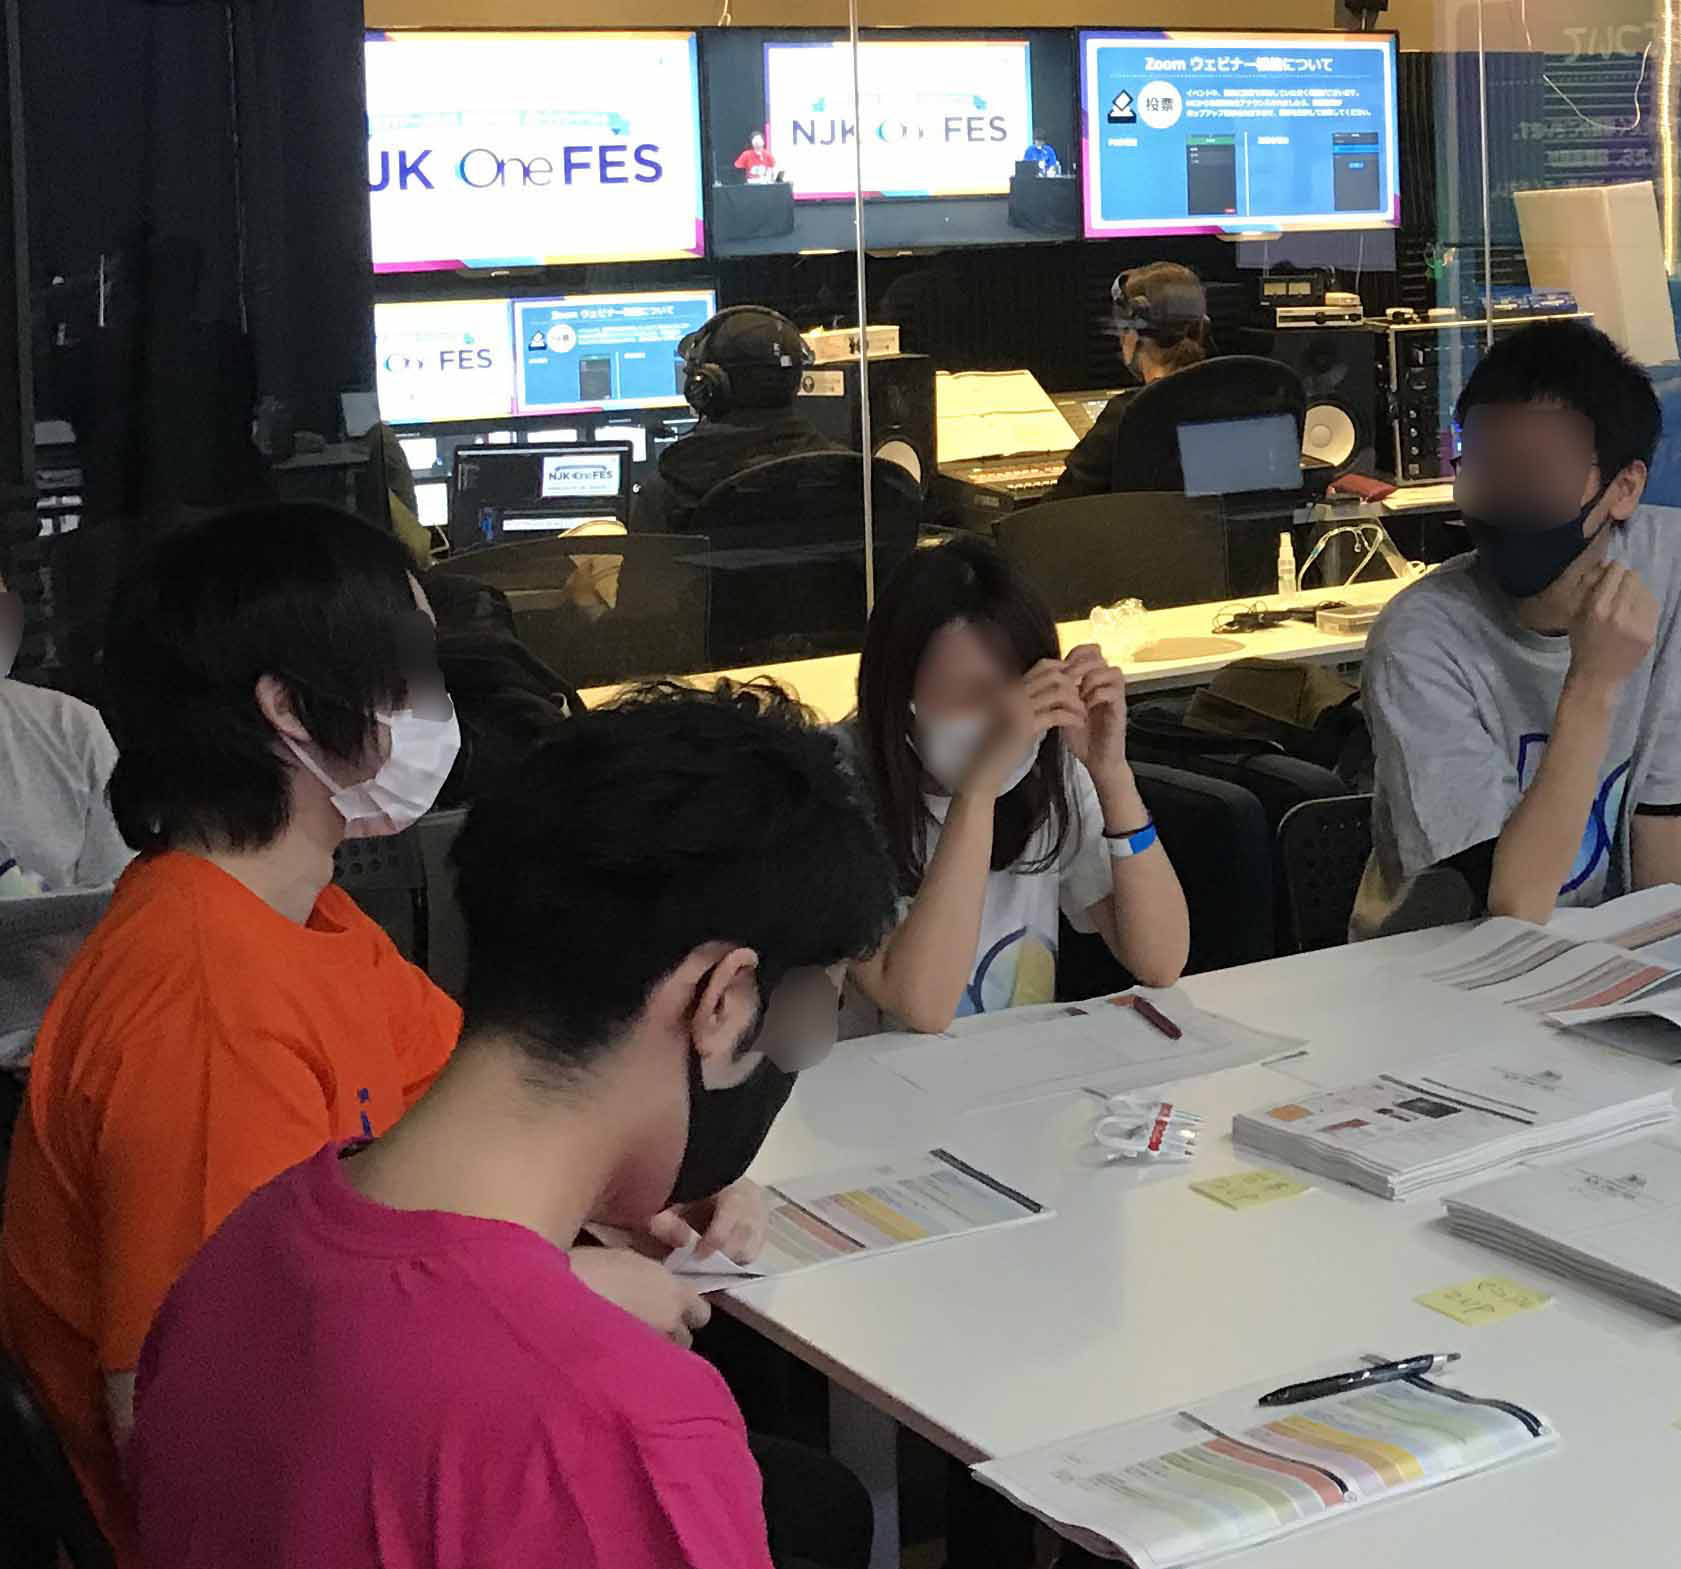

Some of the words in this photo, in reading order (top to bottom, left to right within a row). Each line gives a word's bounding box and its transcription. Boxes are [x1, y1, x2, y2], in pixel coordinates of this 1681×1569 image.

[1146, 56, 1186, 71] Zoom
[1146, 97, 1174, 113] 投票
[792, 119, 856, 146] NJK
[944, 115, 1008, 143] FES
[456, 147, 554, 189] One
[563, 143, 663, 185] FES
[440, 348, 493, 371] FES
[549, 471, 570, 481] NJK
[592, 470, 613, 480] FES
